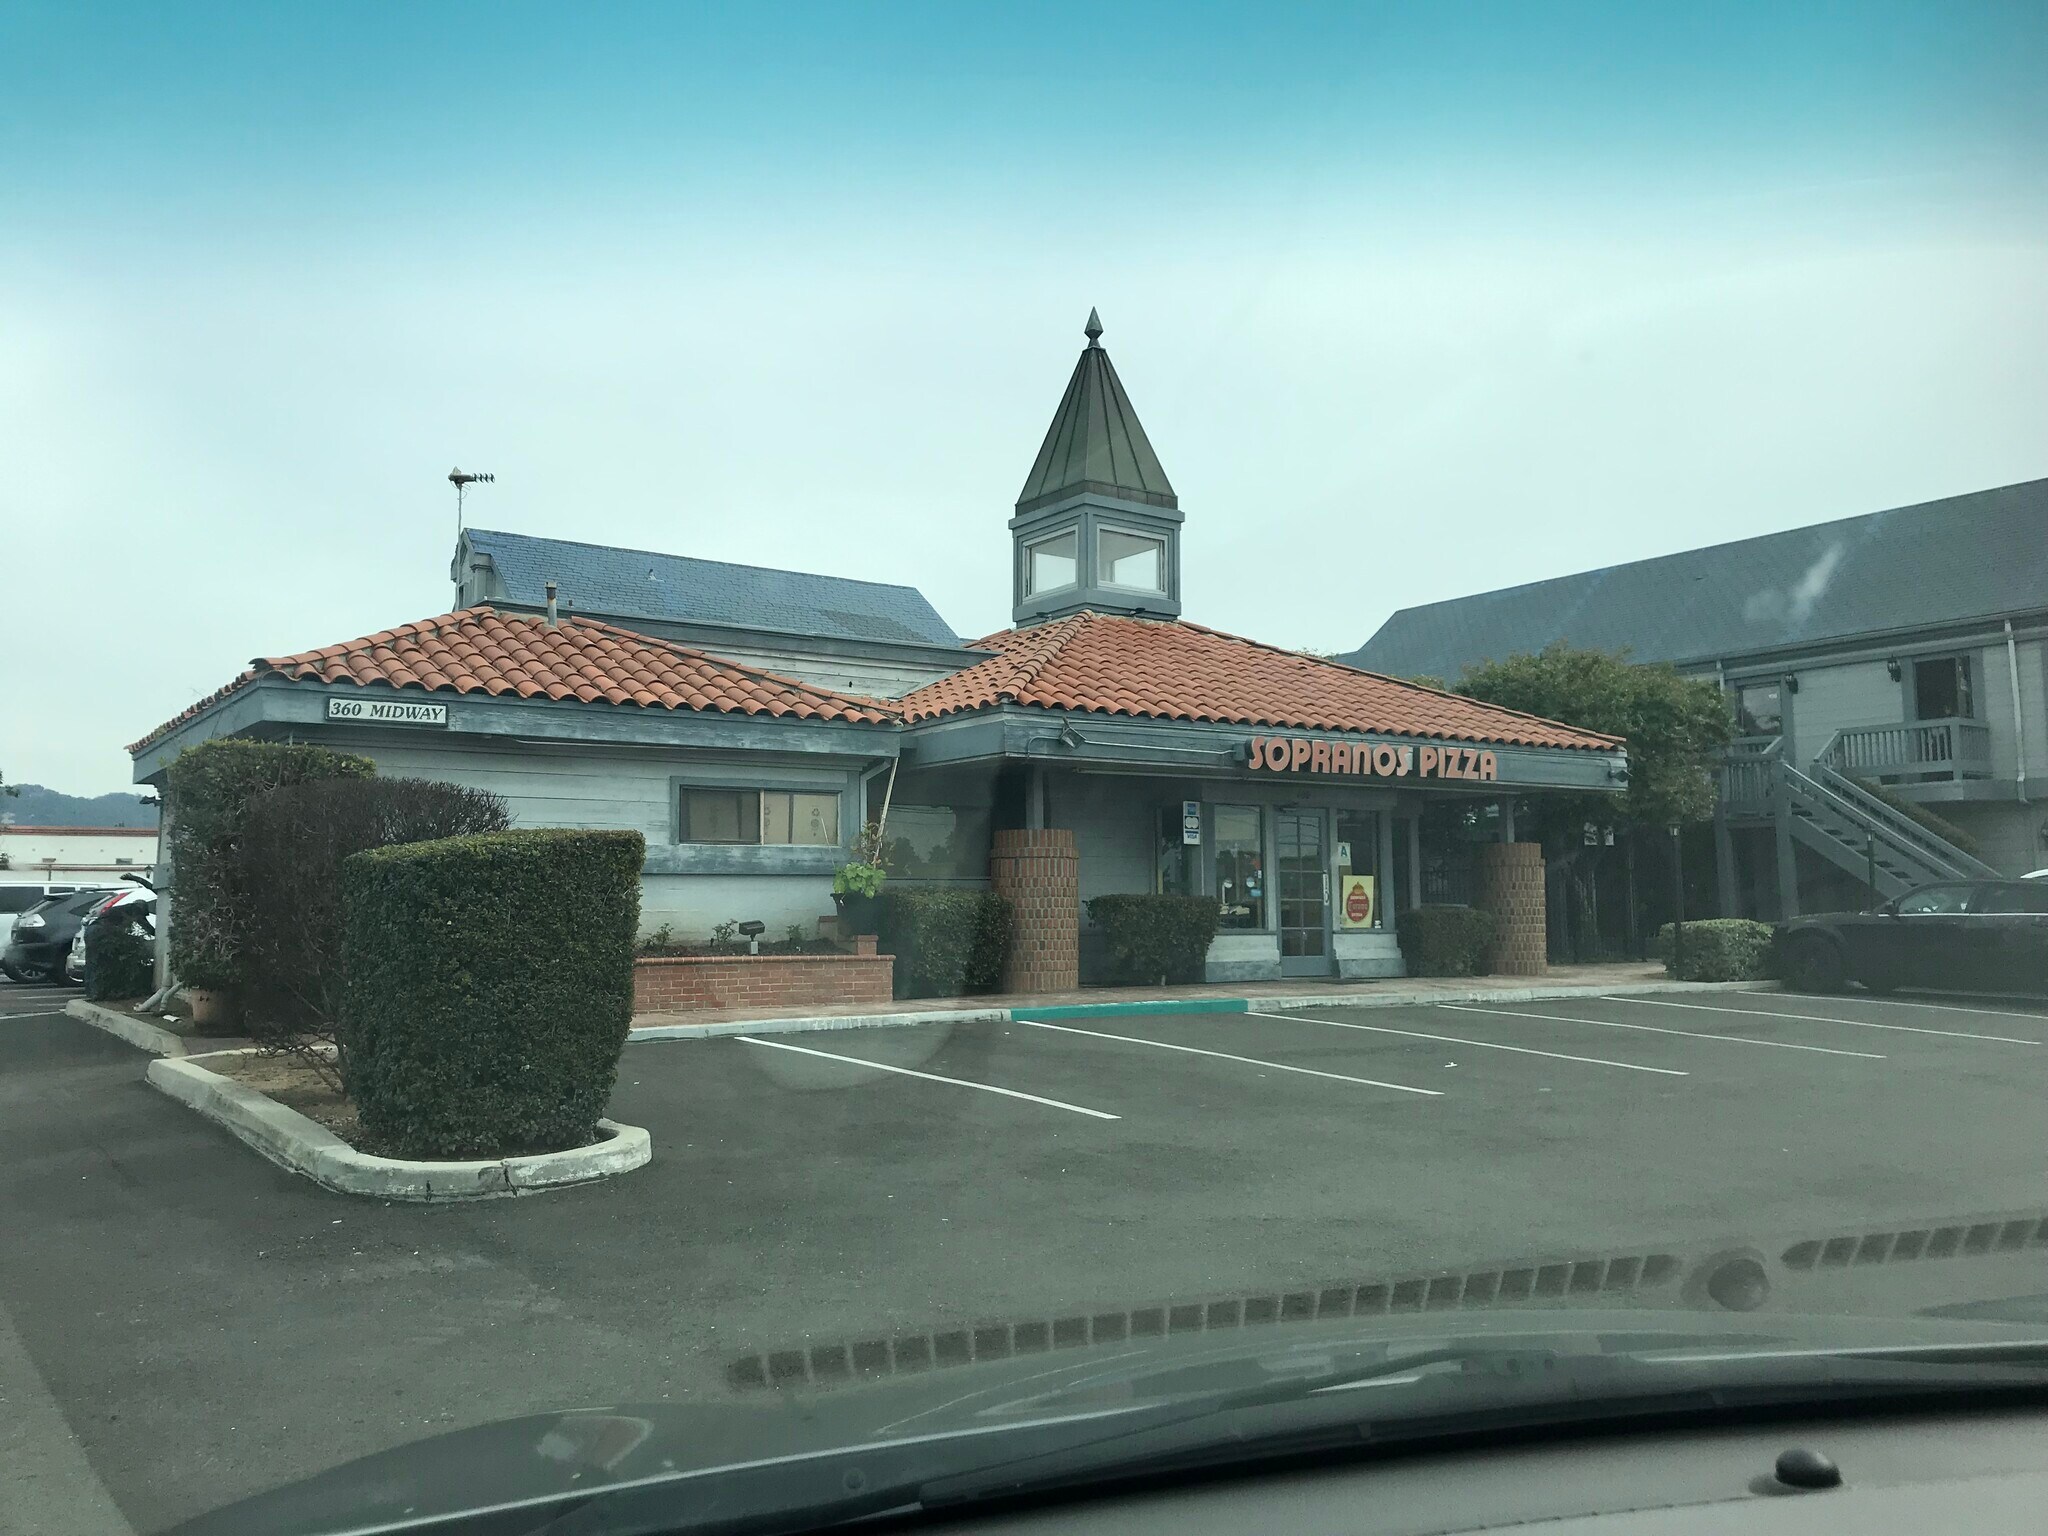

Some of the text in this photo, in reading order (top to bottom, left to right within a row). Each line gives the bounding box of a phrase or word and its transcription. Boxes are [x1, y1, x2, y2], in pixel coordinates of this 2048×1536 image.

[331, 702, 444, 720] 360 MIDWAY
[1419, 746, 1498, 781] PIZZA
[1340, 846, 1348, 857] A
